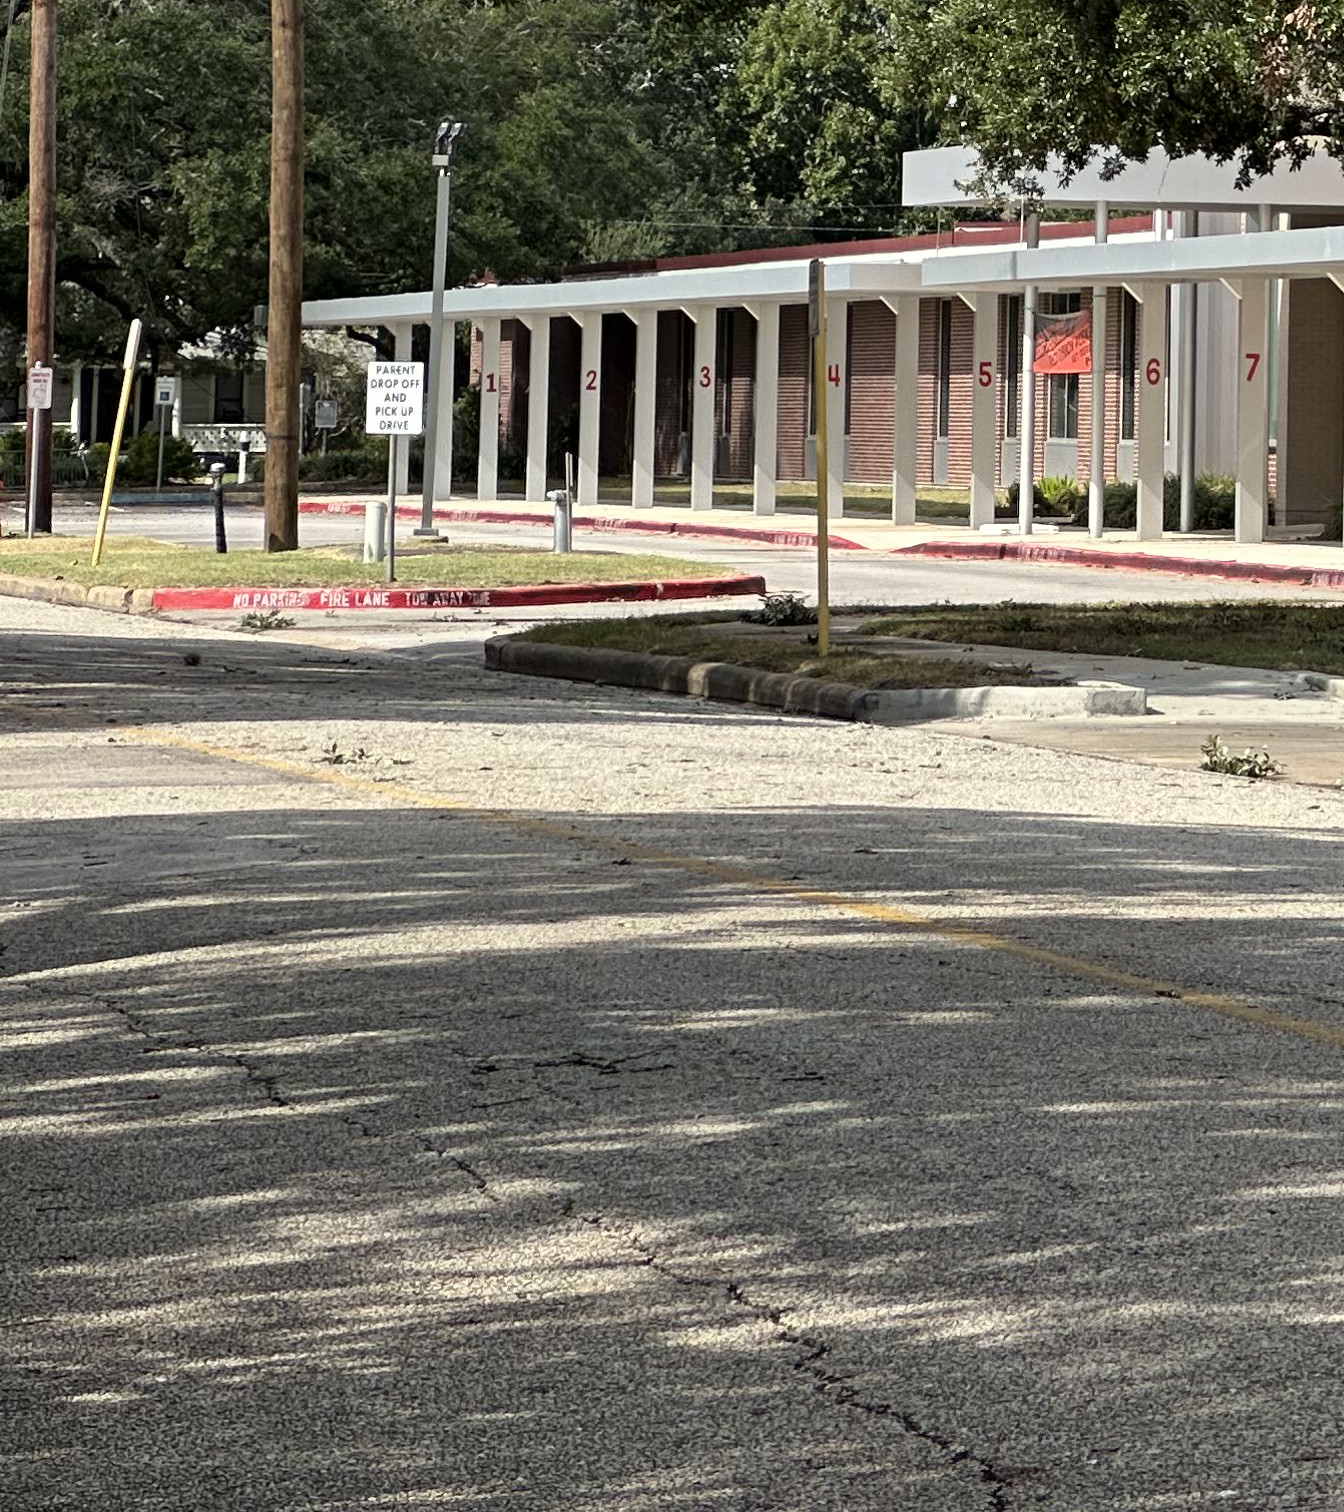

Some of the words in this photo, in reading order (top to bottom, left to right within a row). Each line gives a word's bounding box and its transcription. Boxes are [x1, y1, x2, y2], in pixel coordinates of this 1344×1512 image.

[376, 365, 415, 375] PARENT
[700, 366, 711, 387] 3
[828, 364, 840, 387] 4
[979, 361, 992, 387] 5
[1146, 358, 1160, 385] 6
[1245, 353, 1260, 382] 7
[370, 379, 399, 389] DROP
[401, 379, 420, 389] OFF
[486, 373, 497, 392] 1
[585, 370, 597, 390] 2
[384, 393, 407, 402] AND
[375, 407, 397, 416] PICK
[401, 407, 414, 416] UP
[380, 420, 408, 430] DRIVE
[233, 593, 249, 608] NO
[320, 592, 350, 607] FIRE
[355, 591, 390, 607] LANE
[432, 592, 464, 606] AWAY
